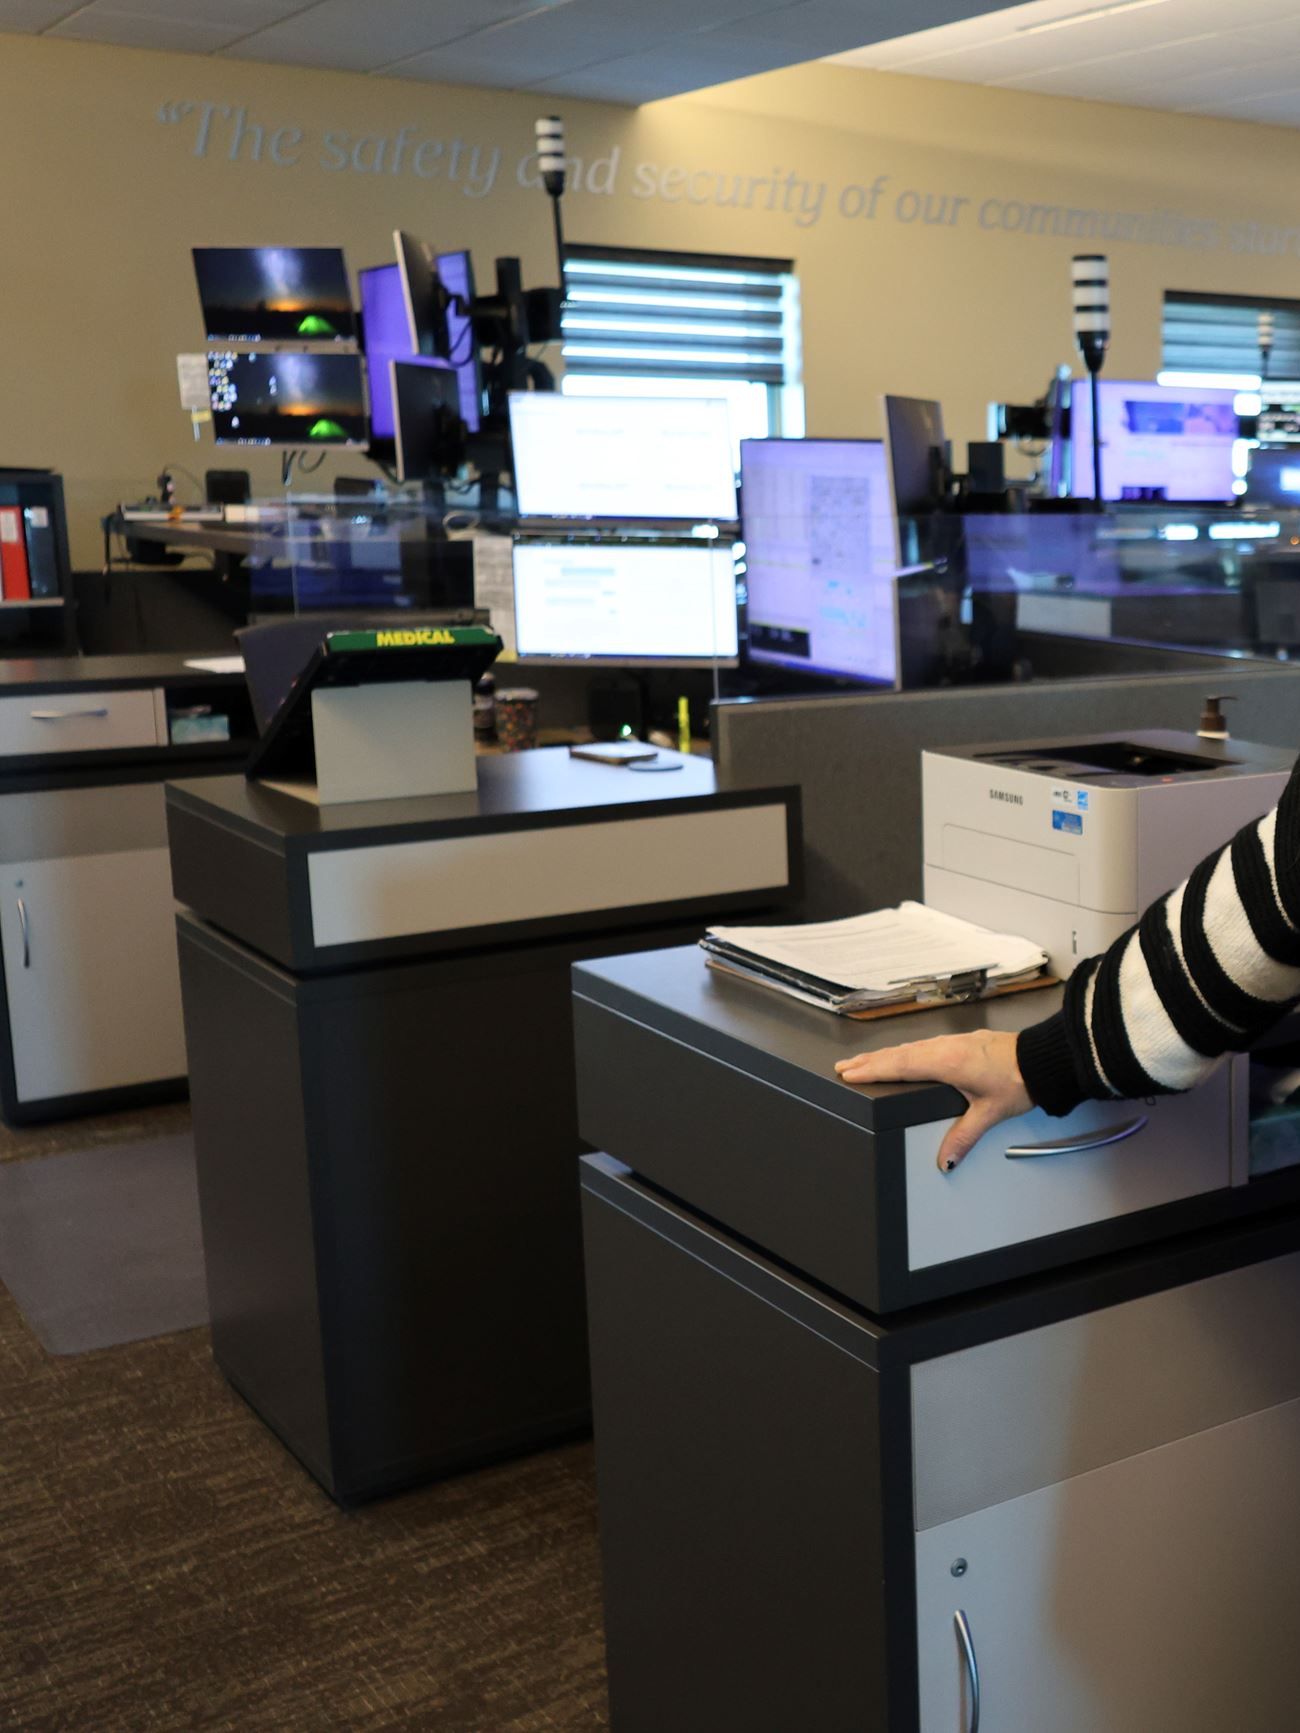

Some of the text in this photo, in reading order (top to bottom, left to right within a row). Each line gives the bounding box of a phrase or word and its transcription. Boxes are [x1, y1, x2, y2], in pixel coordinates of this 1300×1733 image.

[320, 124, 501, 199] safety
[632, 162, 828, 229] security
[838, 174, 889, 220] of
[896, 189, 971, 226] our
[377, 629, 455, 648] MEDICAL
[989, 788, 1024, 806] SAMSUNG
